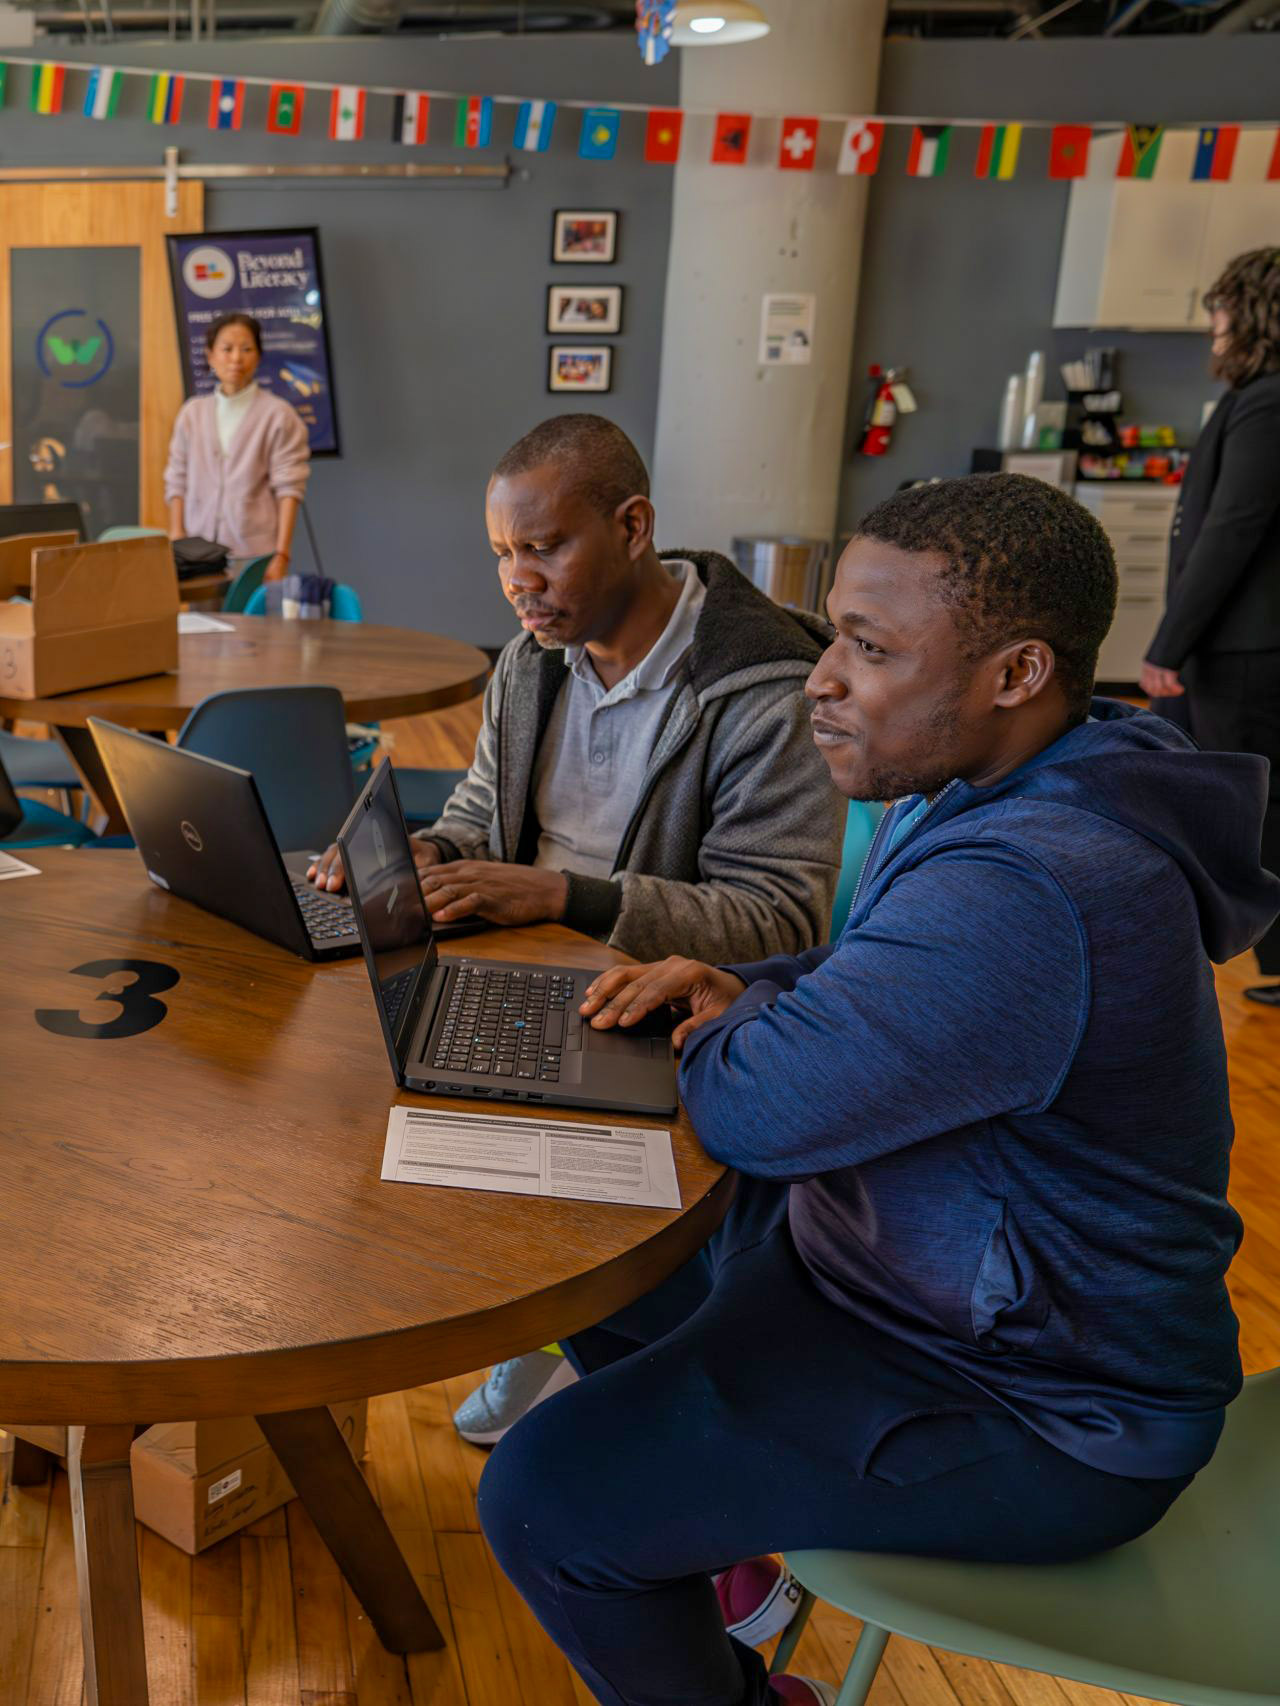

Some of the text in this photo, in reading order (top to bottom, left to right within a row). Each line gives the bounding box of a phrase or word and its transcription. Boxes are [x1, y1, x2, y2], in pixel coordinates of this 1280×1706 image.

[237, 247, 304, 273] Beyond
[239, 270, 310, 290] Literacy
[34, 958, 181, 1039] 3
